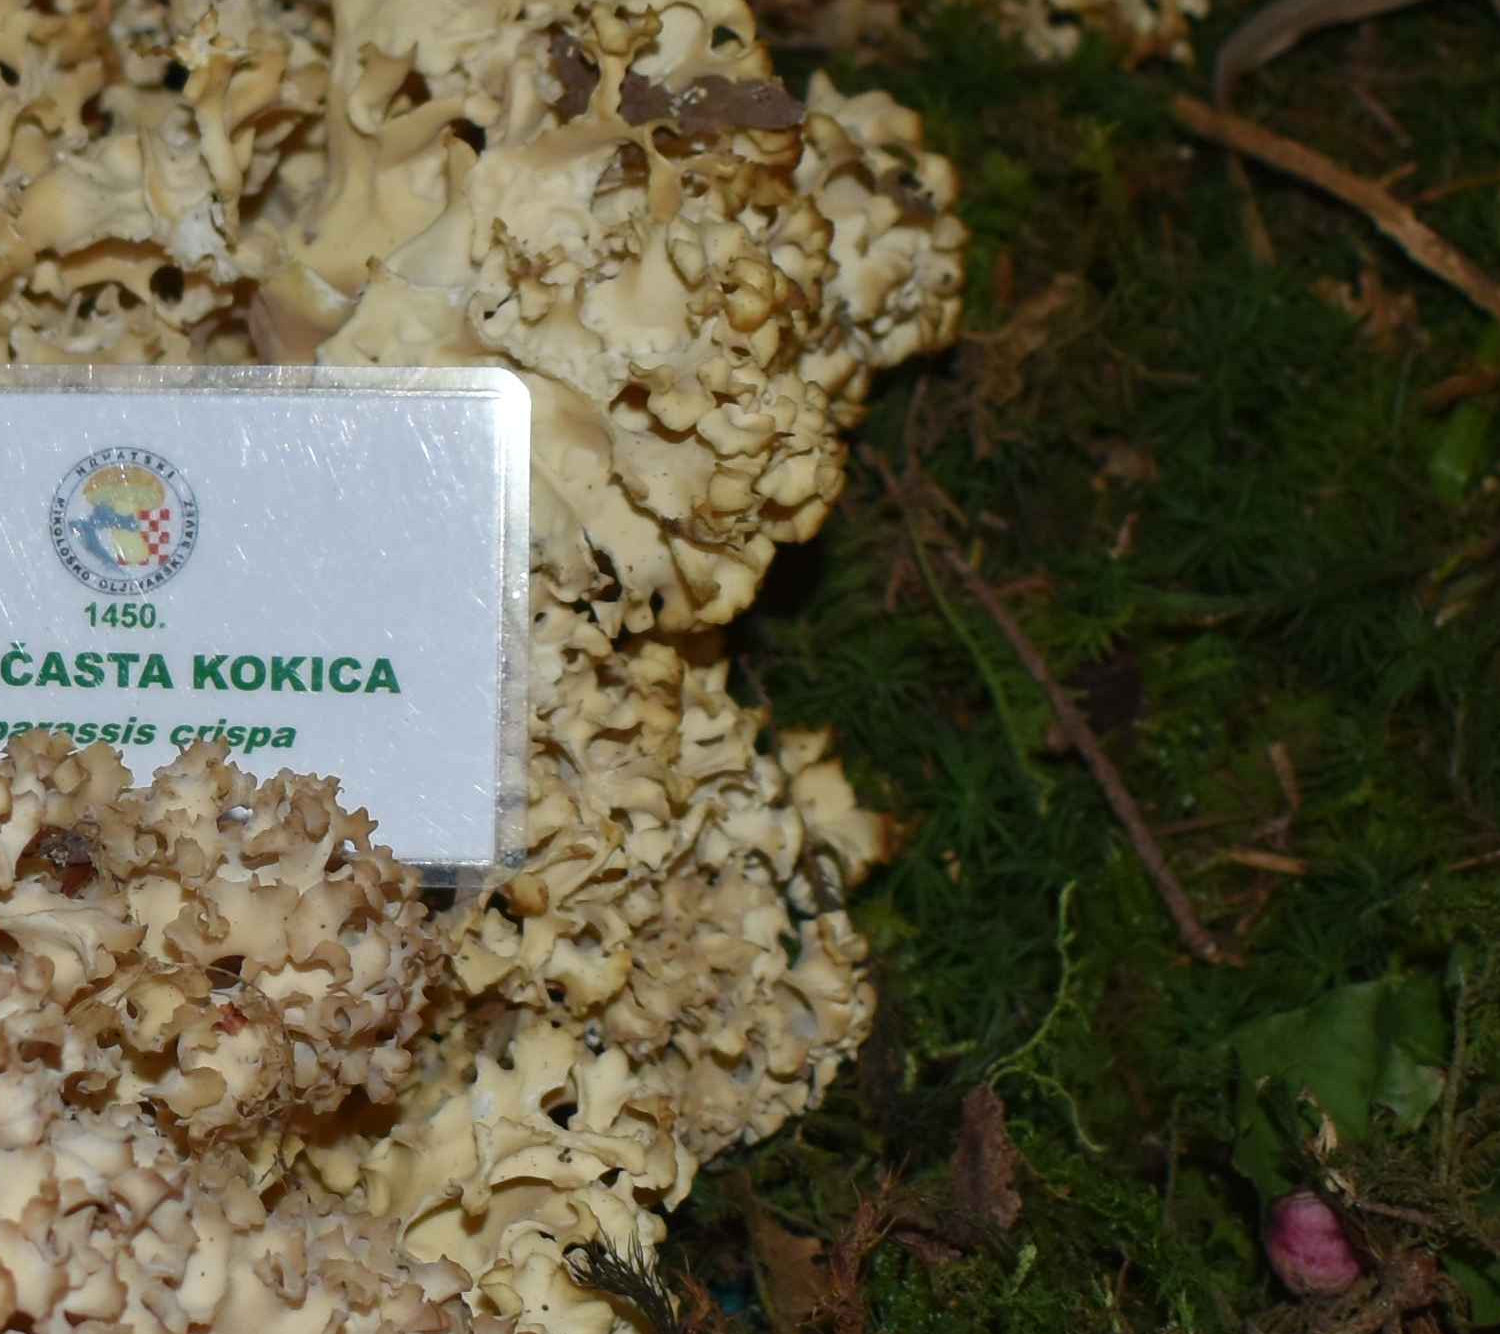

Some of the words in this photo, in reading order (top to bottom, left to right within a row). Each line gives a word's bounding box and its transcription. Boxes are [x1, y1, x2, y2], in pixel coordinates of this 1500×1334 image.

[84, 602, 165, 629] 1450.
[193, 654, 401, 694] KOKICA
[169, 718, 297, 755] crispa
